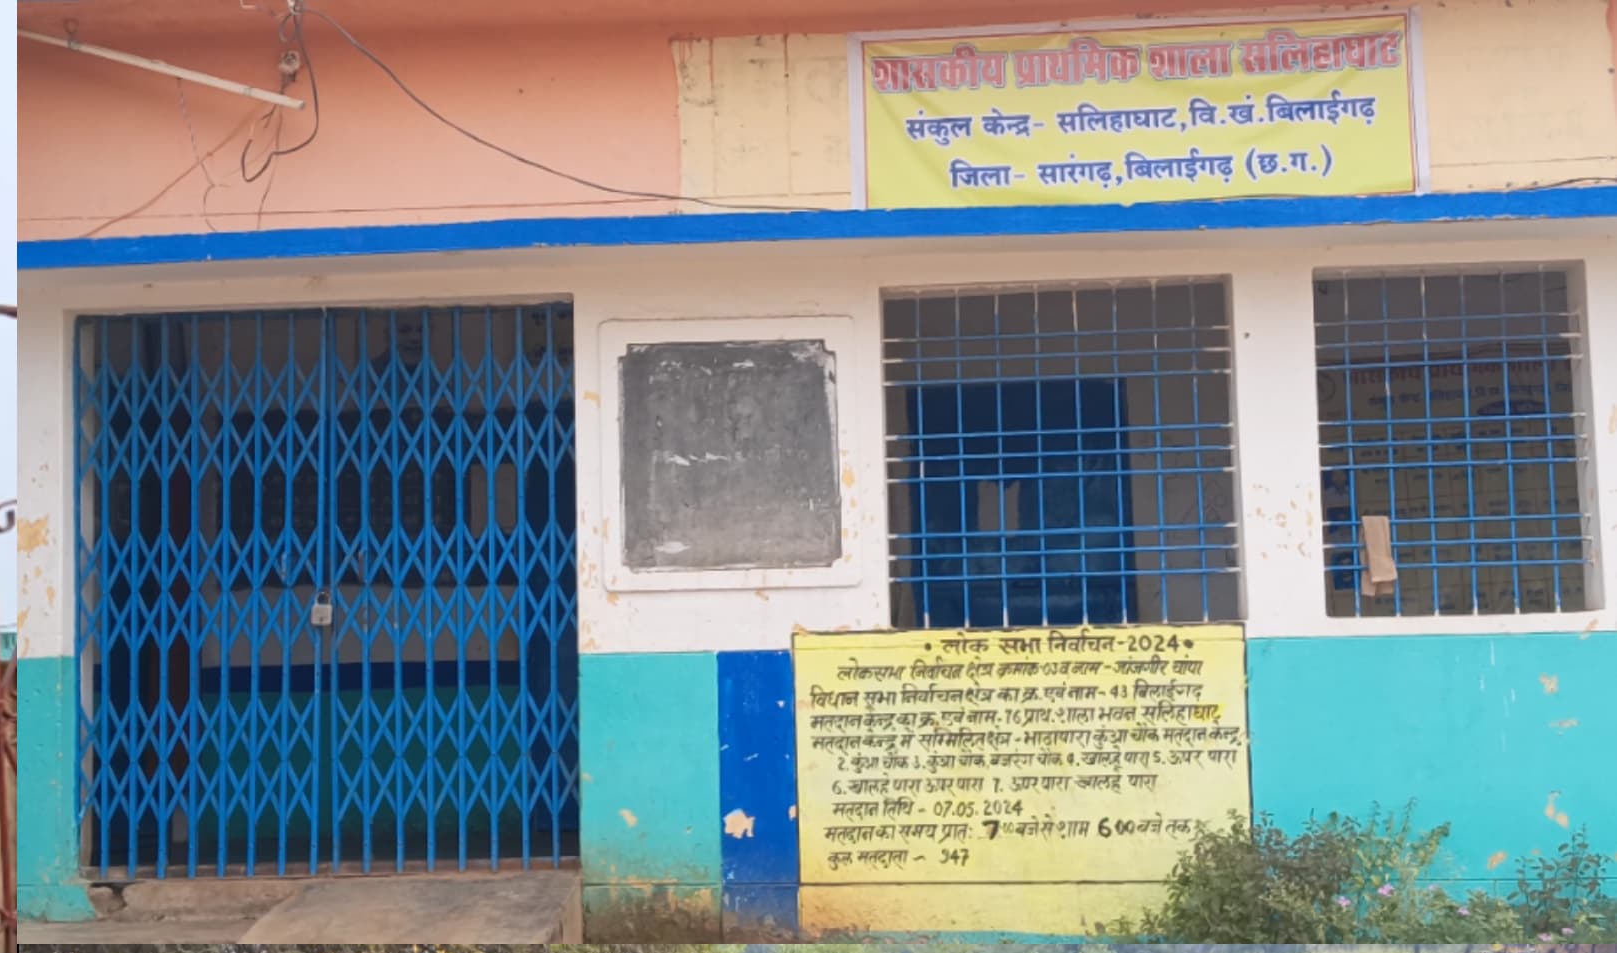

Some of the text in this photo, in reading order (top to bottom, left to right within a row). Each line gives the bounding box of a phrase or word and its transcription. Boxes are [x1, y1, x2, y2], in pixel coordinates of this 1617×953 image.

[872, 28, 1403, 92] शासकीय प्राथमिक शाला सलिहाघाट
[905, 109, 973, 146] संकुल
[940, 631, 990, 655] लोक
[998, 637, 1041, 655] सभा
[837, 658, 905, 682] लोकसभा
[910, 656, 965, 680] निर्वाचन
[810, 684, 860, 709] विधान
[864, 689, 897, 708] सभा
[901, 683, 964, 706] निर्वाचन
[997, 686, 1020, 704] का
[810, 714, 863, 733] मतदान
[897, 712, 917, 728] का
[1098, 705, 1137, 722] भवन
[1140, 700, 1222, 726] सलिहाघाट
[811, 735, 862, 755] मतदान
[1162, 727, 1207, 748] मतदान
[1123, 751, 1151, 769] पारा
[1206, 749, 1238, 769] पारा
[832, 801, 880, 822] मतदान
[823, 824, 876, 845] मतदान
[876, 824, 896, 841] का
[898, 822, 938, 844] समय
[827, 850, 853, 871] कुल
[856, 848, 910, 870] मतदाता
